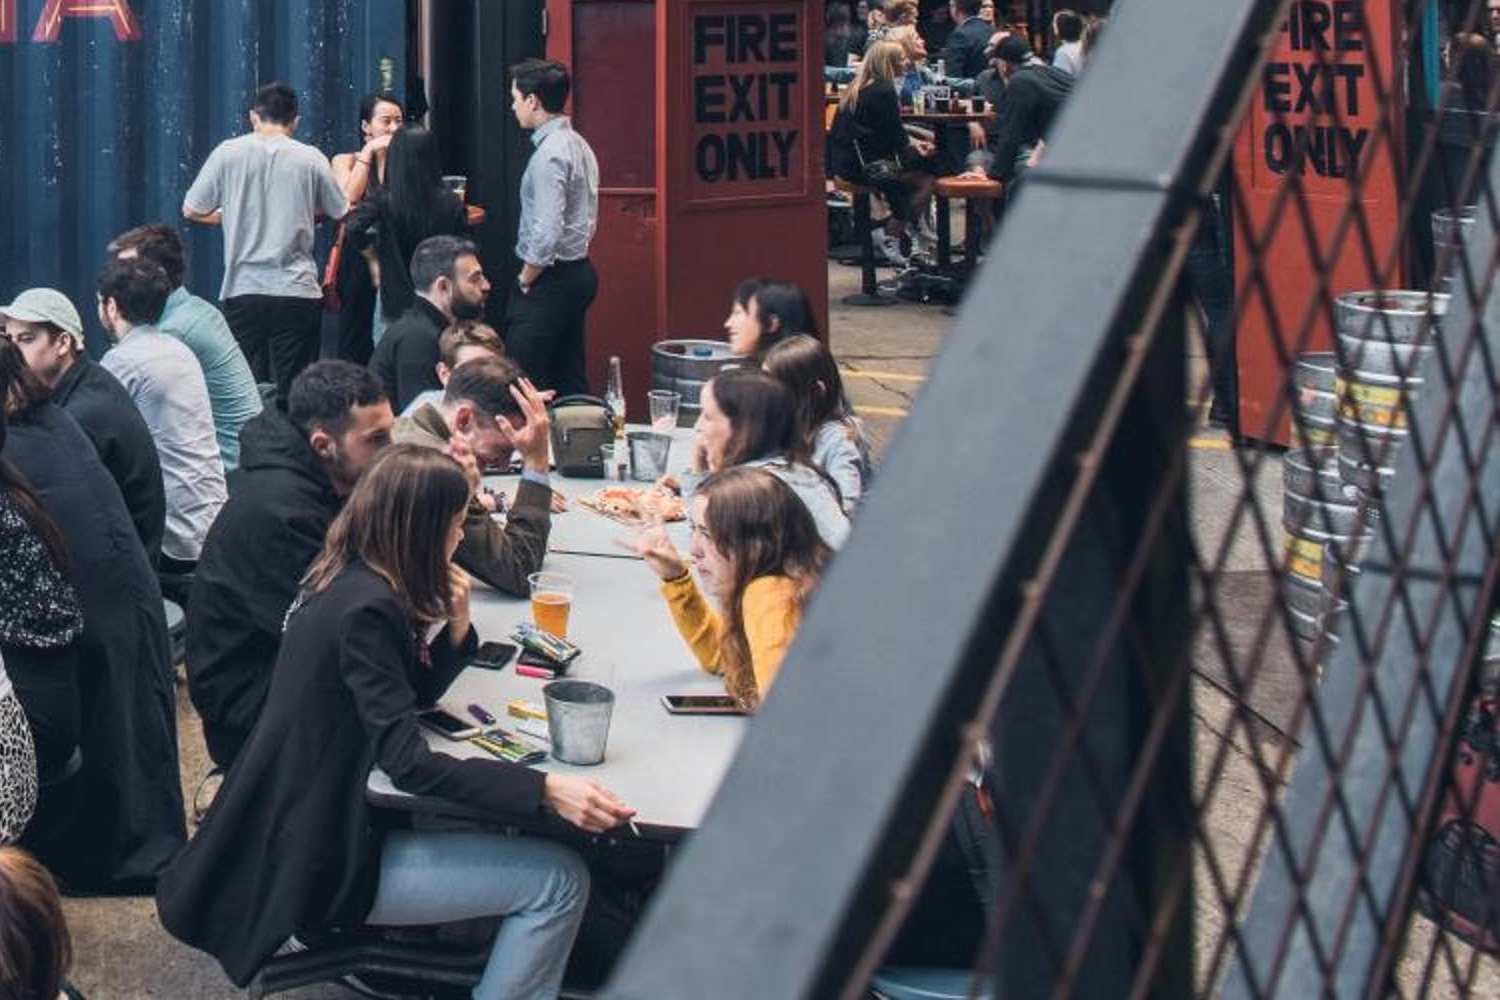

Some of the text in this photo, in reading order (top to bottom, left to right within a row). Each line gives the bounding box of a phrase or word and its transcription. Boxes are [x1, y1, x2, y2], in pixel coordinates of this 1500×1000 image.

[694, 13, 797, 64] FIRE
[1280, 0, 1364, 52] IRE
[694, 73, 798, 124] EXIT
[1264, 62, 1364, 116] EXIT
[694, 130, 800, 183] ONLY
